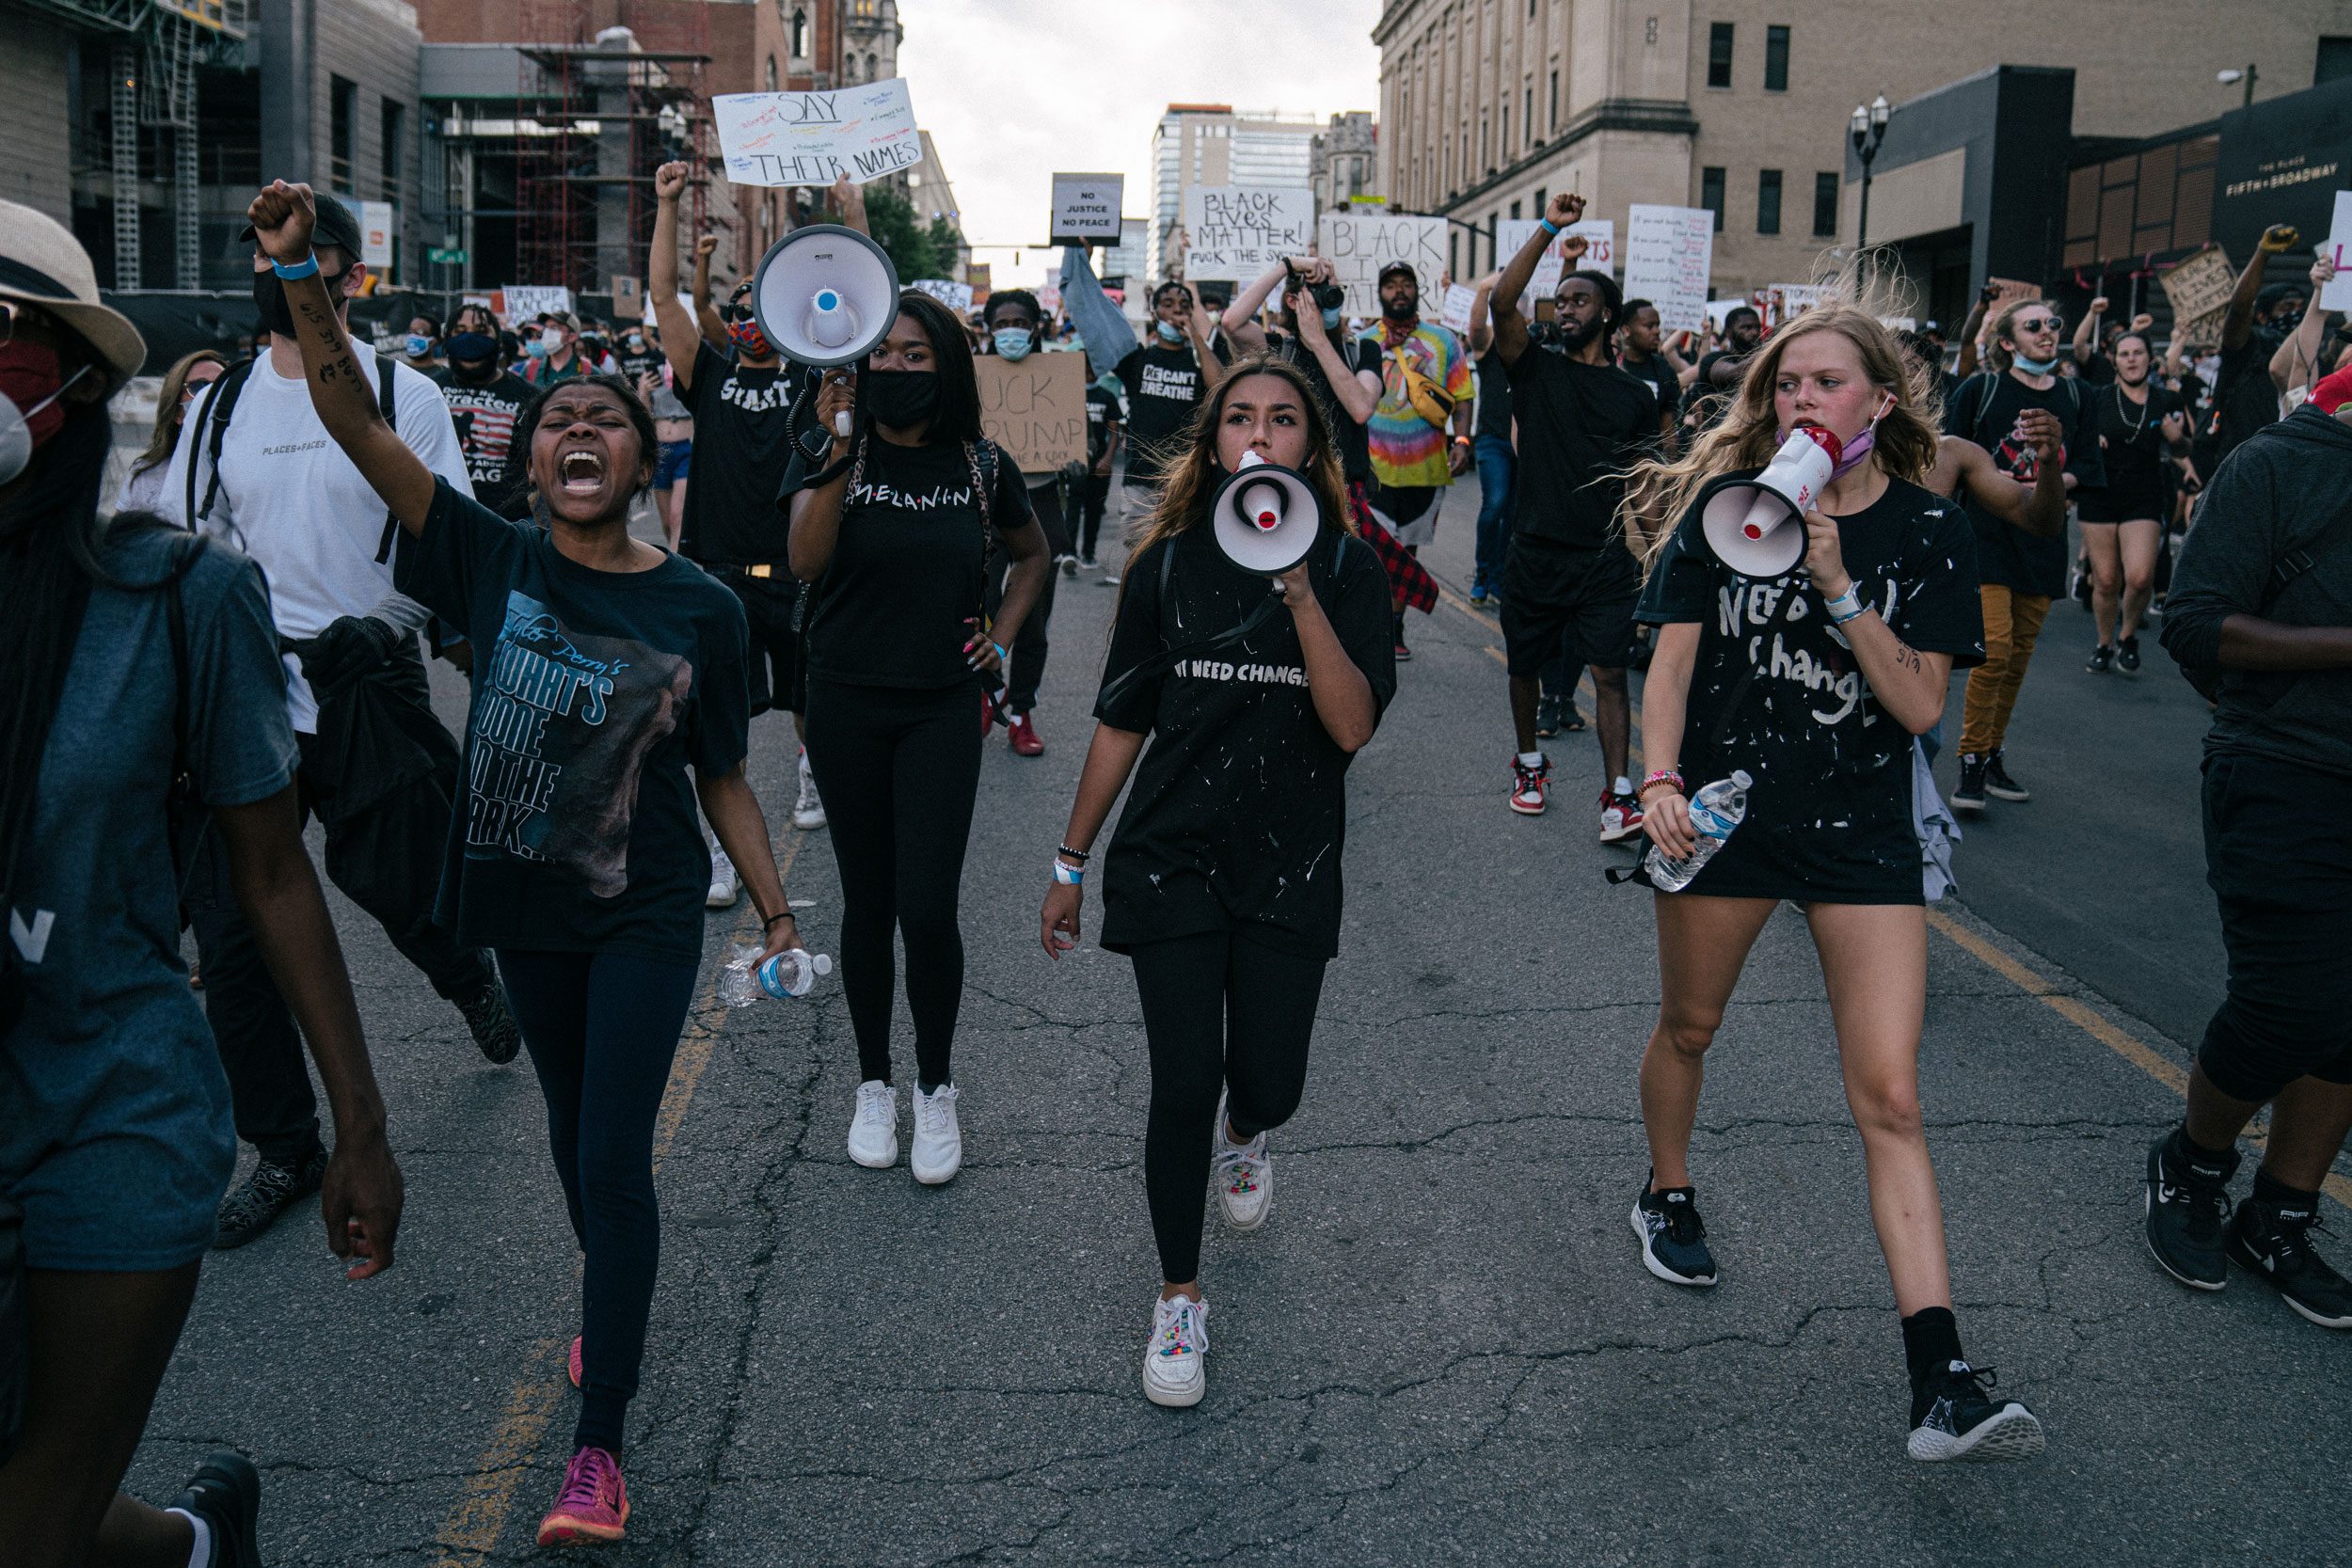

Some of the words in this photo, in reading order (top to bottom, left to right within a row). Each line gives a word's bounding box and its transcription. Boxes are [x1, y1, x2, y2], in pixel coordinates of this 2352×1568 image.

[778, 93, 836, 122] SAY
[750, 154, 845, 182] THEIR
[853, 141, 919, 177] NAMES
[2270, 162, 2339, 188] BROADWAY
[1204, 193, 1284, 214] BLACK
[1199, 221, 1303, 246] MATTER!
[1332, 220, 1442, 261] BLACK
[1190, 249, 1226, 265] FUCK
[1232, 249, 1260, 262] THE
[2171, 253, 2217, 288] BLACK
[2180, 266, 2228, 299] LIVES
[1139, 380, 1195, 401] BREATHE
[1163, 370, 1197, 385] CAN'T
[978, 374, 1055, 414] UCK
[262, 439, 327, 455] PLACES+FACES
[983, 419, 1083, 451] RUMP
[476, 459, 506, 468] About
[552, 633, 629, 676] Perry's
[495, 640, 613, 726] WHAT'S
[1192, 659, 1234, 681] NEED
[475, 687, 551, 758] DONE
[495, 751, 562, 814] THE
